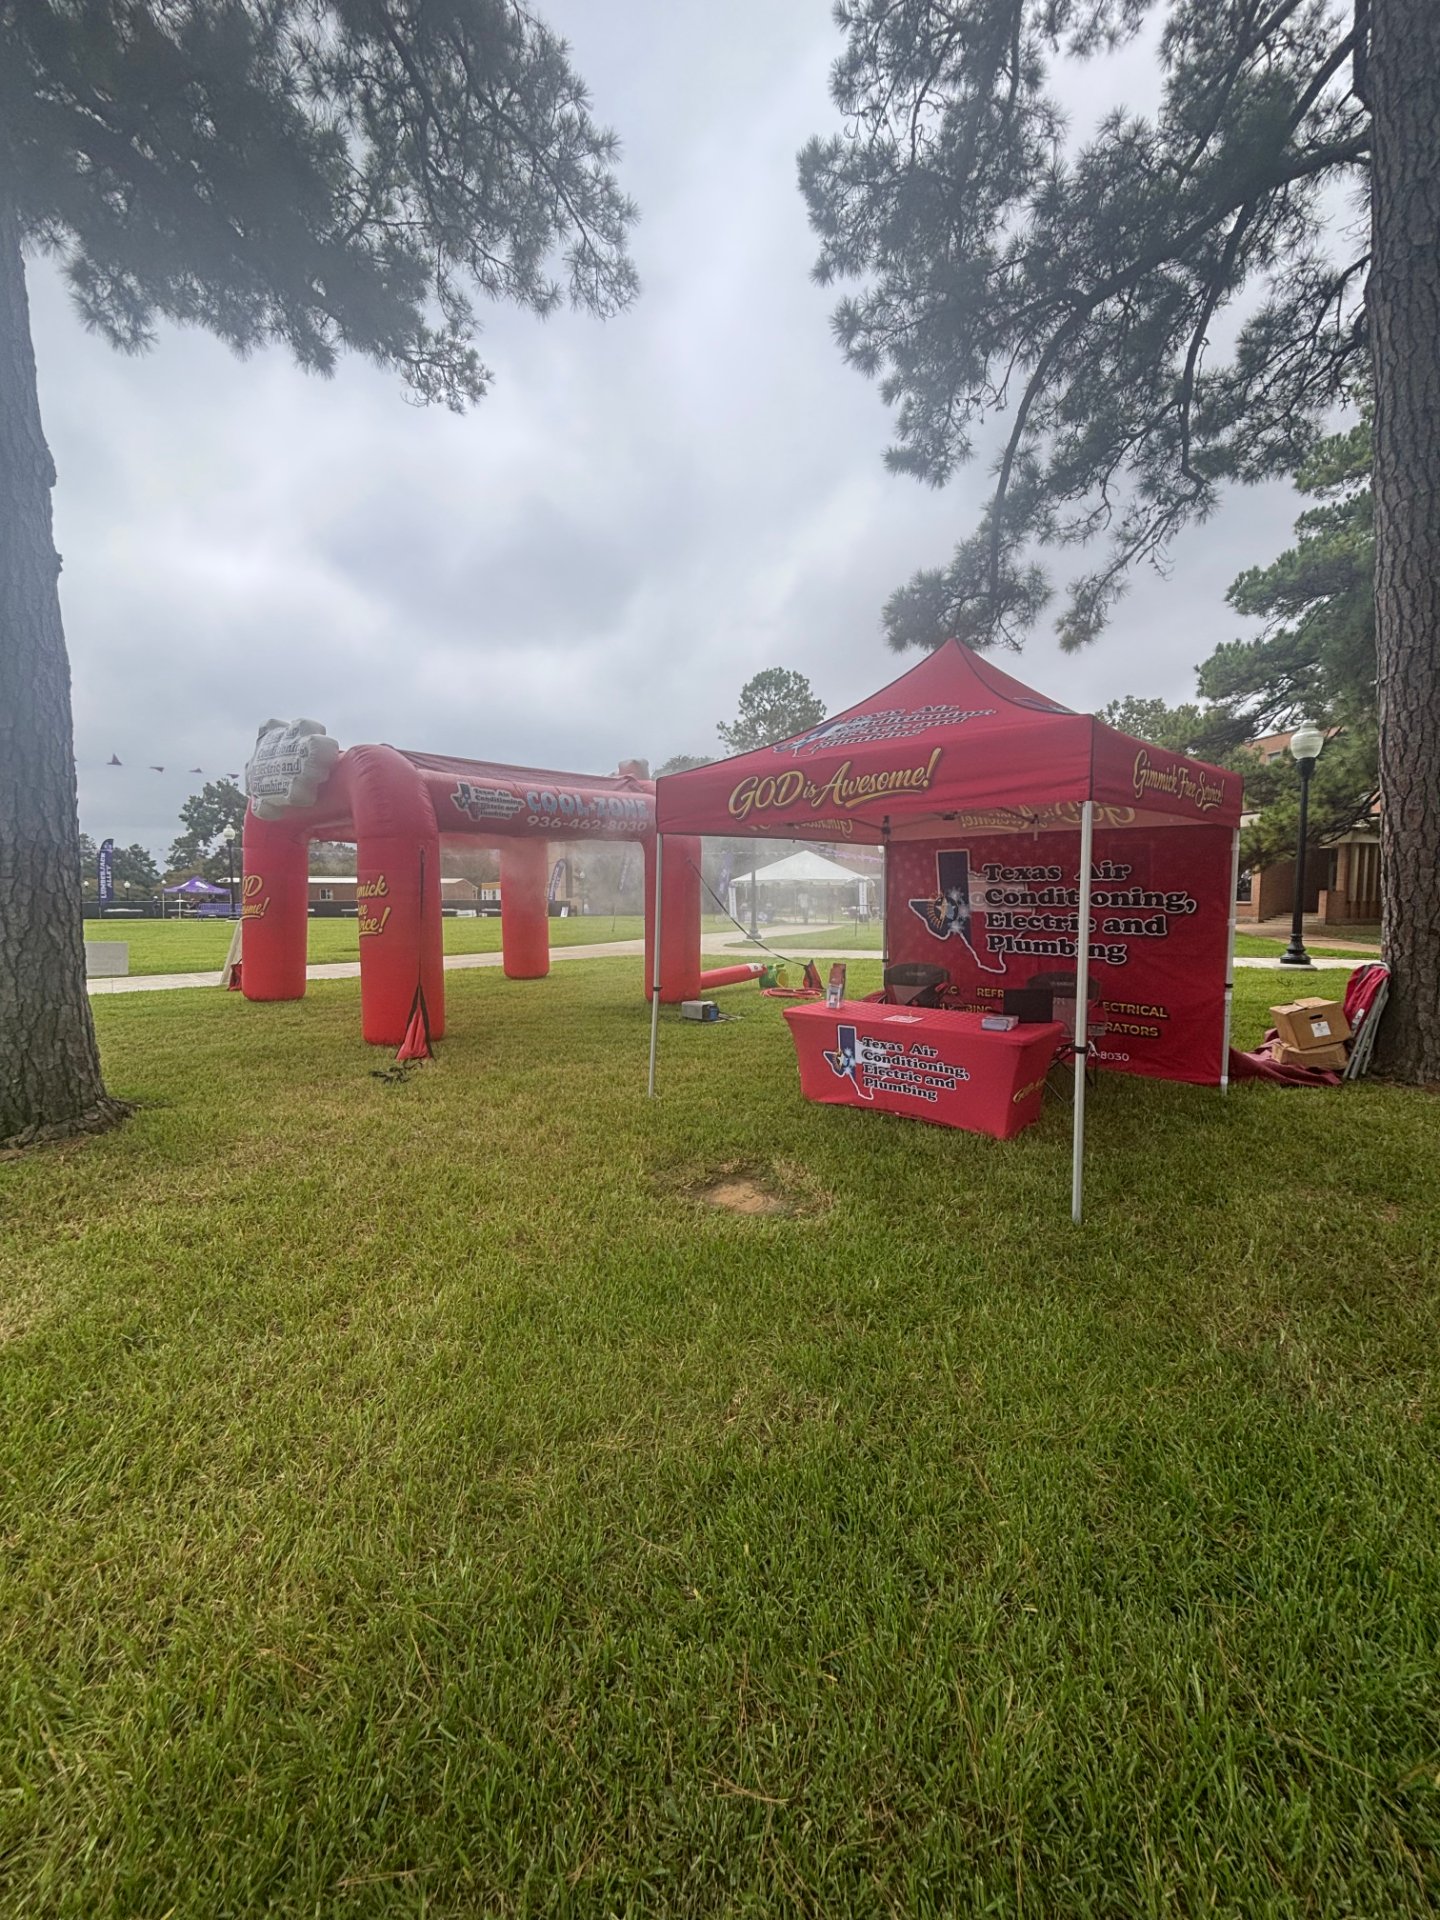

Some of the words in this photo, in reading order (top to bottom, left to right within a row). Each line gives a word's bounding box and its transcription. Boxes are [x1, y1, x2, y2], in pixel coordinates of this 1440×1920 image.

[281, 757, 301, 775] and
[728, 770, 804, 820] GOD
[803, 779, 817, 799] is
[811, 747, 942, 808] Awesome!
[1133, 749, 1178, 798] Gimmick
[1178, 767, 1196, 799] Free
[1195, 771, 1225, 811] Service!
[527, 791, 589, 816] COOL
[593, 796, 647, 817] ZONE
[527, 815, 648, 831] 936-462-8030
[983, 864, 1061, 882] Texas
[985, 887, 1197, 913] Conditoning,
[1102, 915, 1169, 935] and
[987, 935, 1127, 964] Plumbng
[1102, 1001, 1168, 1018] ECTRICAL
[1105, 1022, 1158, 1037] RATORS
[862, 1037, 904, 1053] Texas
[910, 1044, 938, 1057] Air
[862, 1049, 970, 1081] Conditioning,
[862, 1063, 922, 1083] Electric
[925, 1076, 957, 1090] and
[863, 1077, 938, 1102] Plumbing
